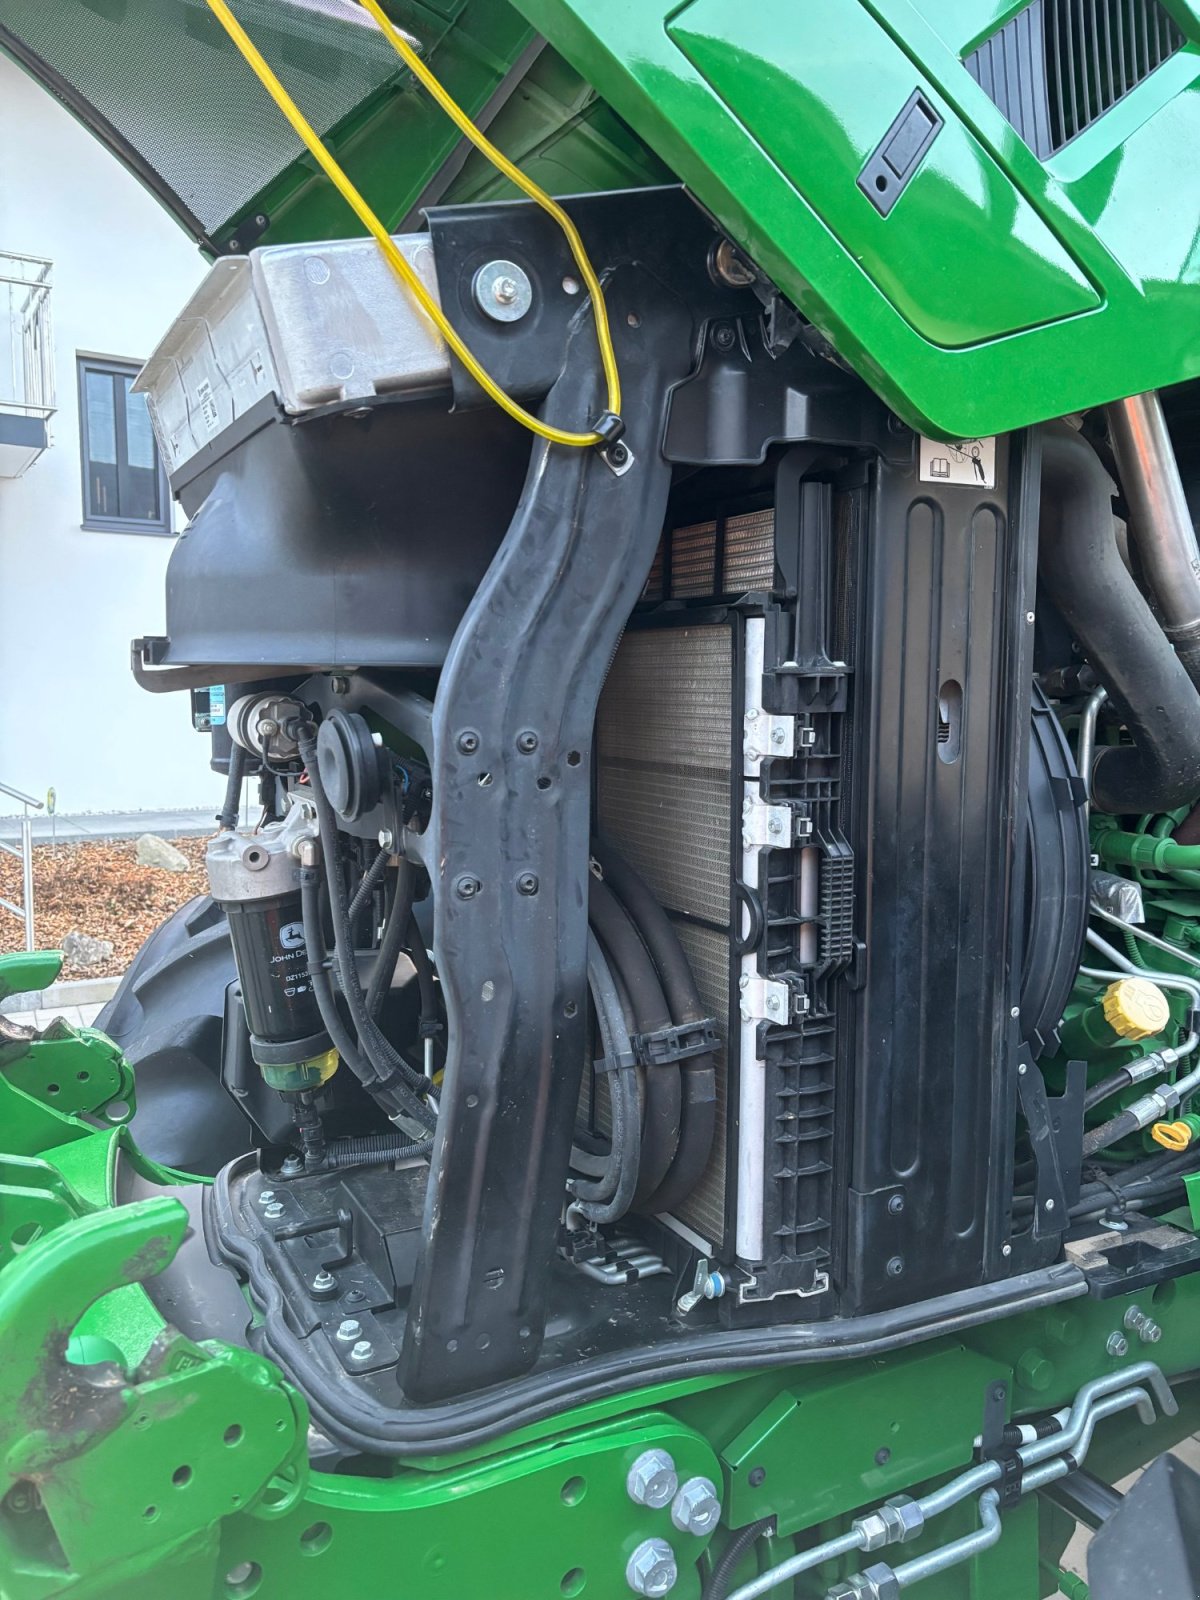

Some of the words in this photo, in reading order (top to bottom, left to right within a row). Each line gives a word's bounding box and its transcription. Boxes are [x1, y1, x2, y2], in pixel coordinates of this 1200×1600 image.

[270, 953, 295, 963] JOHN
[295, 949, 308, 958] DE
[285, 971, 311, 982] DZ1153
